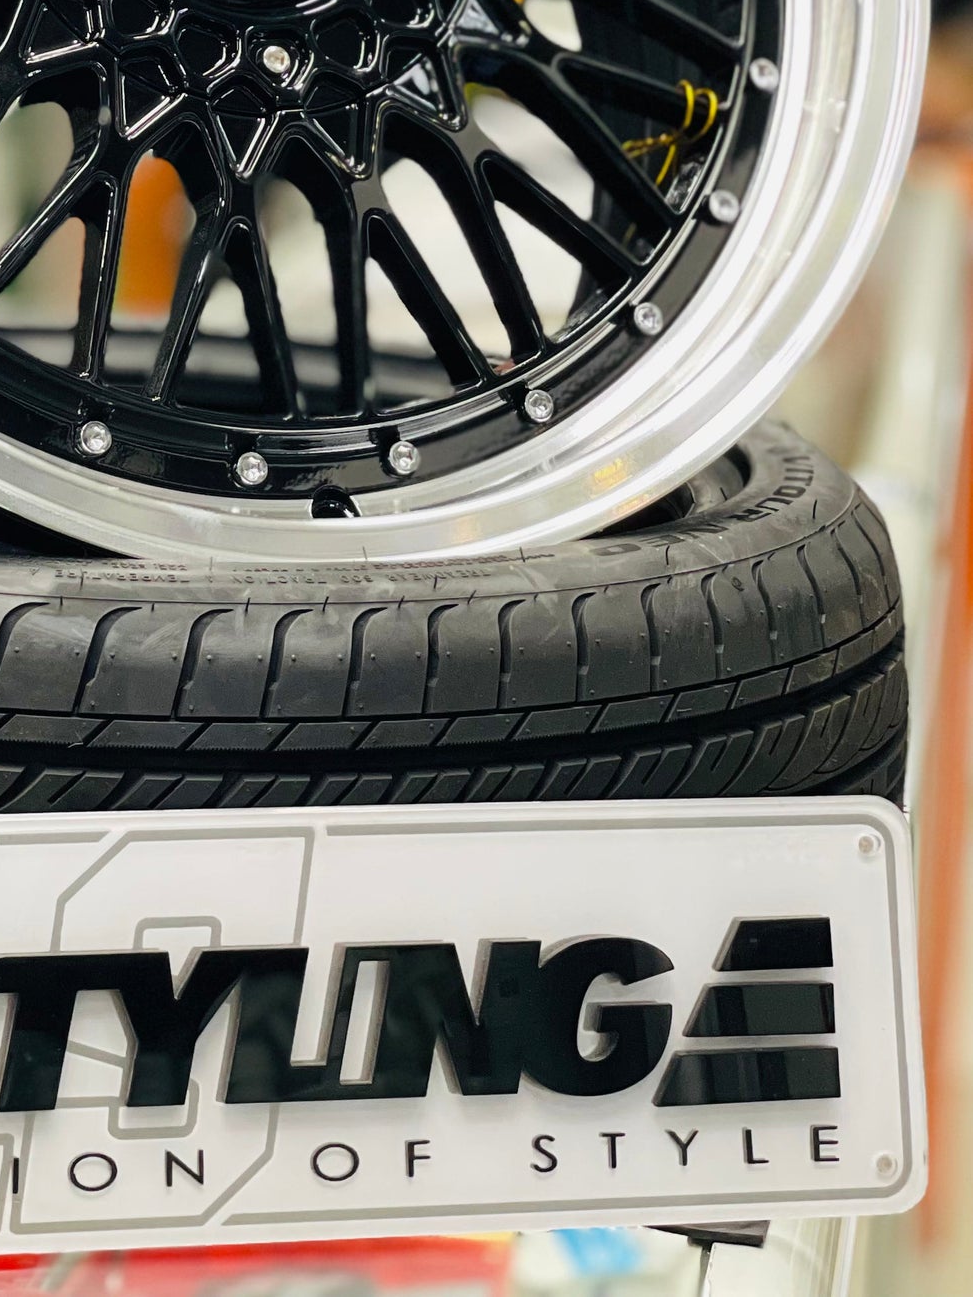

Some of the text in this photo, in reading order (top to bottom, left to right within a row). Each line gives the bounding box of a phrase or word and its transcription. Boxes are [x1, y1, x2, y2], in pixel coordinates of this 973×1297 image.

[728, 455, 815, 523] VITOUR
[311, 1138, 432, 1183] OF
[529, 1123, 841, 1175] STYLE
